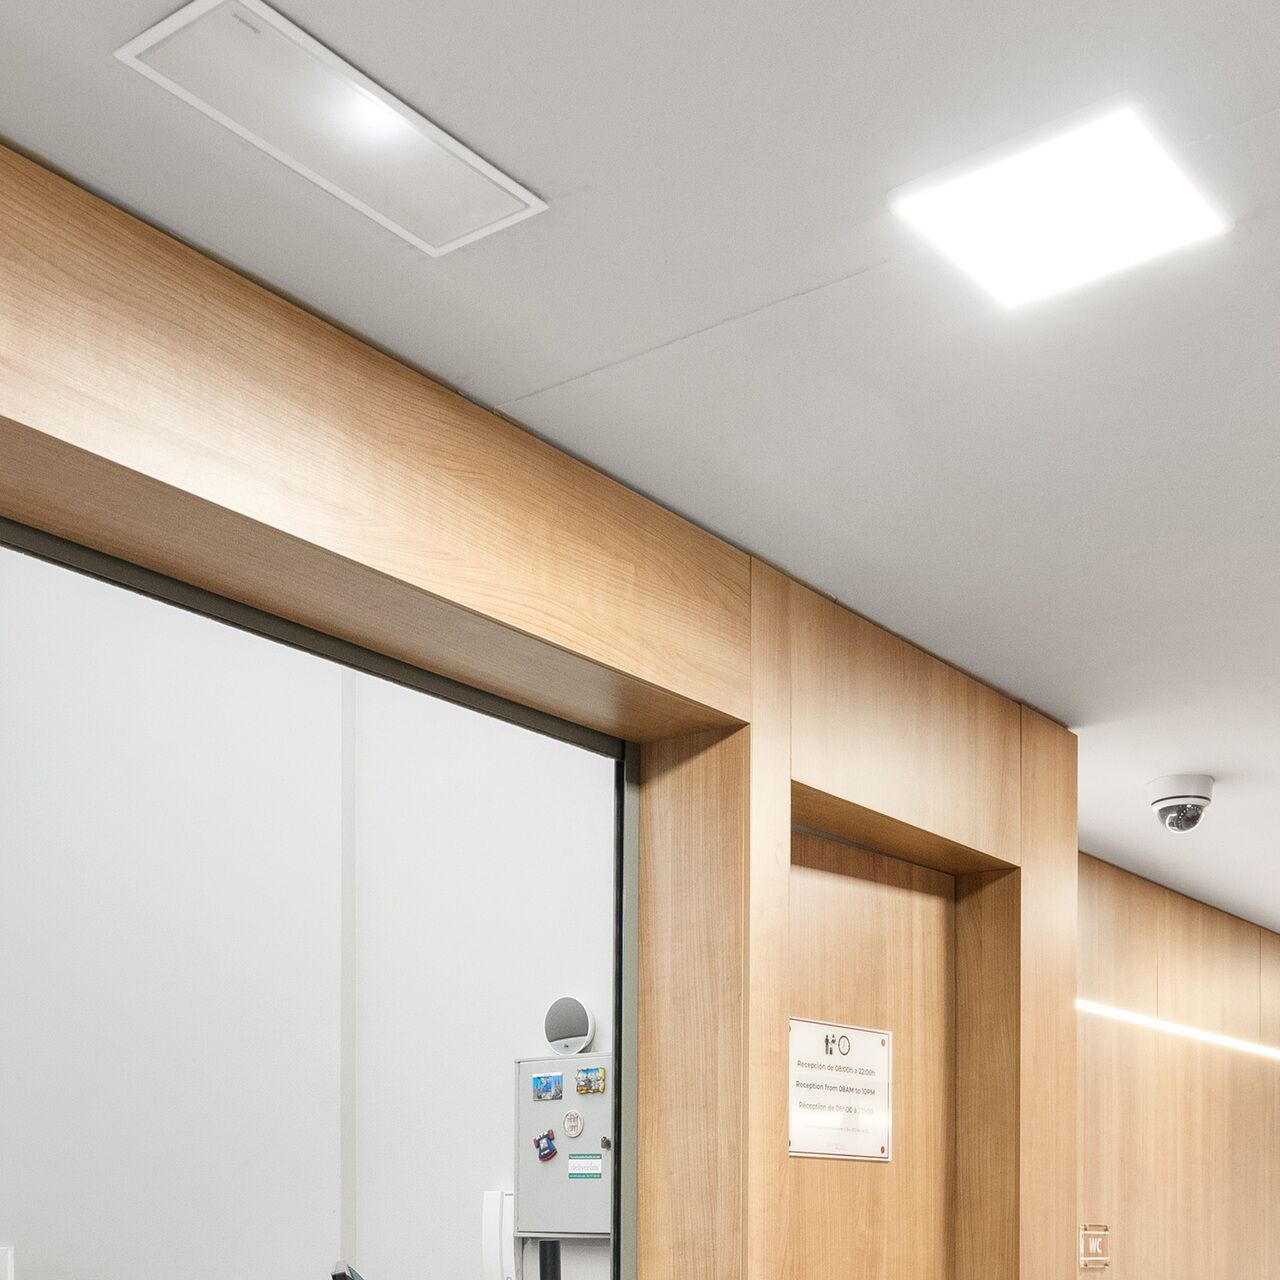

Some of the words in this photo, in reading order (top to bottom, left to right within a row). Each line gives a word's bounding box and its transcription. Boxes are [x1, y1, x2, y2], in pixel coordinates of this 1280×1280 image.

[796, 1080, 824, 1090] Reception
[825, 1083, 838, 1091] from
[1088, 1238, 1102, 1253] WC
